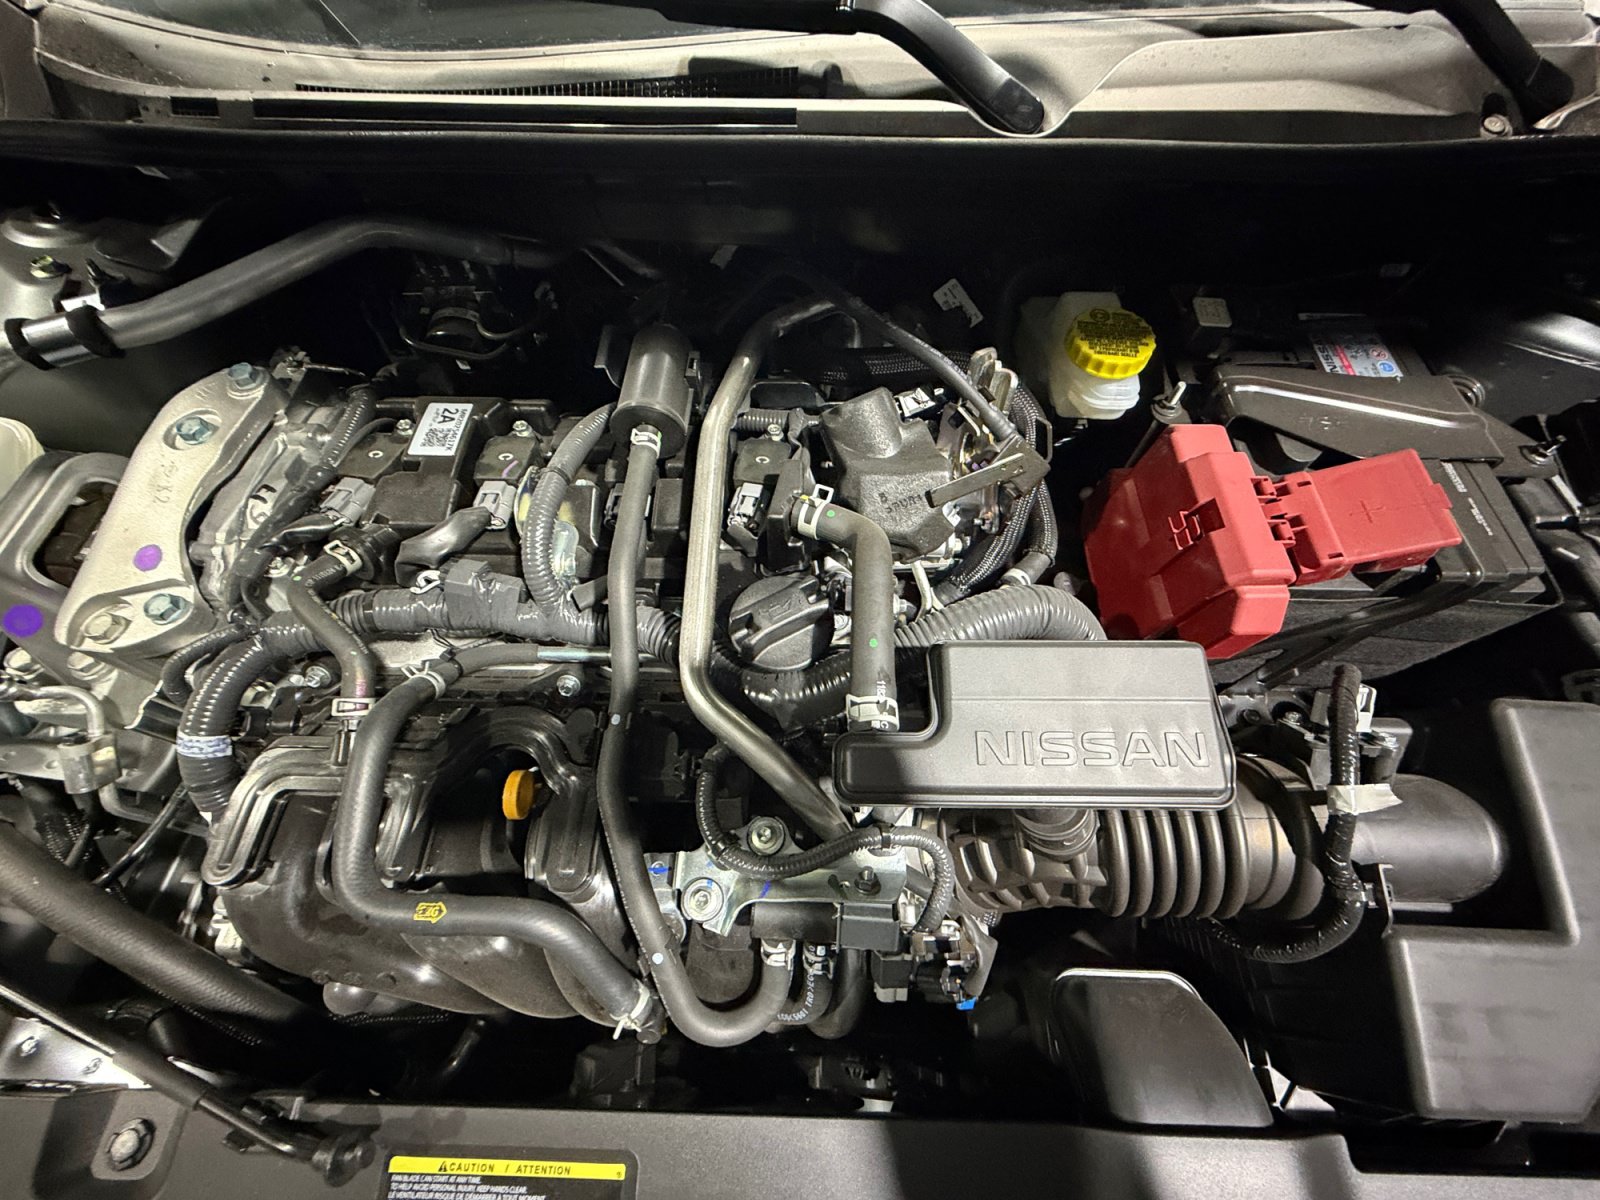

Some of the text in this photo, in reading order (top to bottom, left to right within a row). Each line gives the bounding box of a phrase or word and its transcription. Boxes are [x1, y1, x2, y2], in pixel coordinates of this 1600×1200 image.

[437, 407, 460, 424] 2A
[974, 730, 1210, 767] NISSAN
[449, 1162, 495, 1173] CAUTION
[515, 1164, 571, 1175] ATTENTION
